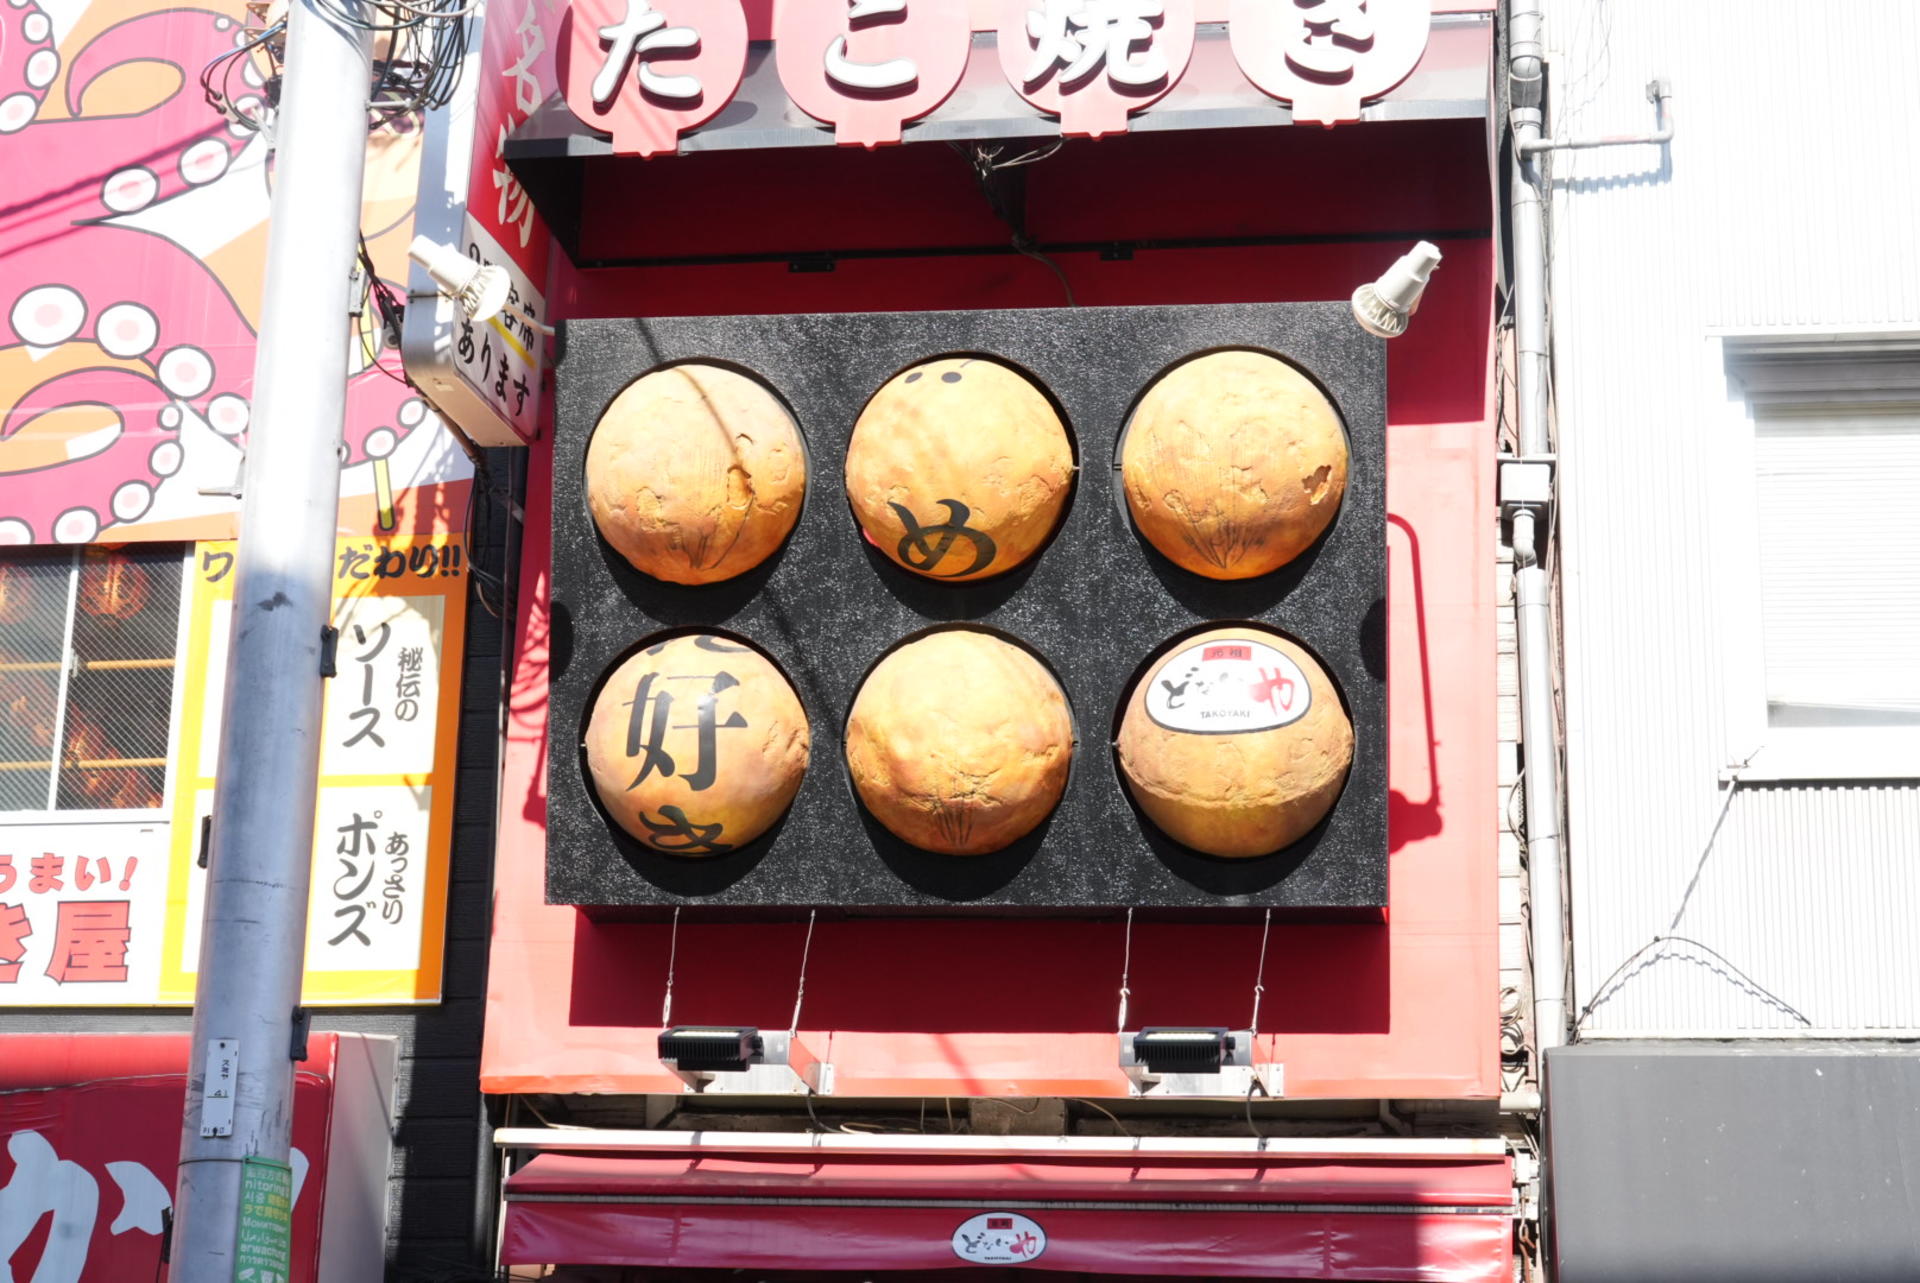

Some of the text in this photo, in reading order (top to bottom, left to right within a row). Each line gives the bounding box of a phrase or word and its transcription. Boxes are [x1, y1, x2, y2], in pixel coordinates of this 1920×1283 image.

[591, 0, 1376, 108] たこ焼き
[457, 318, 531, 417] あります
[342, 622, 391, 748] ソース
[395, 646, 424, 722] 秘伝の
[1200, 710, 1251, 720] TAKOYAKI
[327, 810, 383, 947] ポンズ
[382, 831, 410, 925] あっさり
